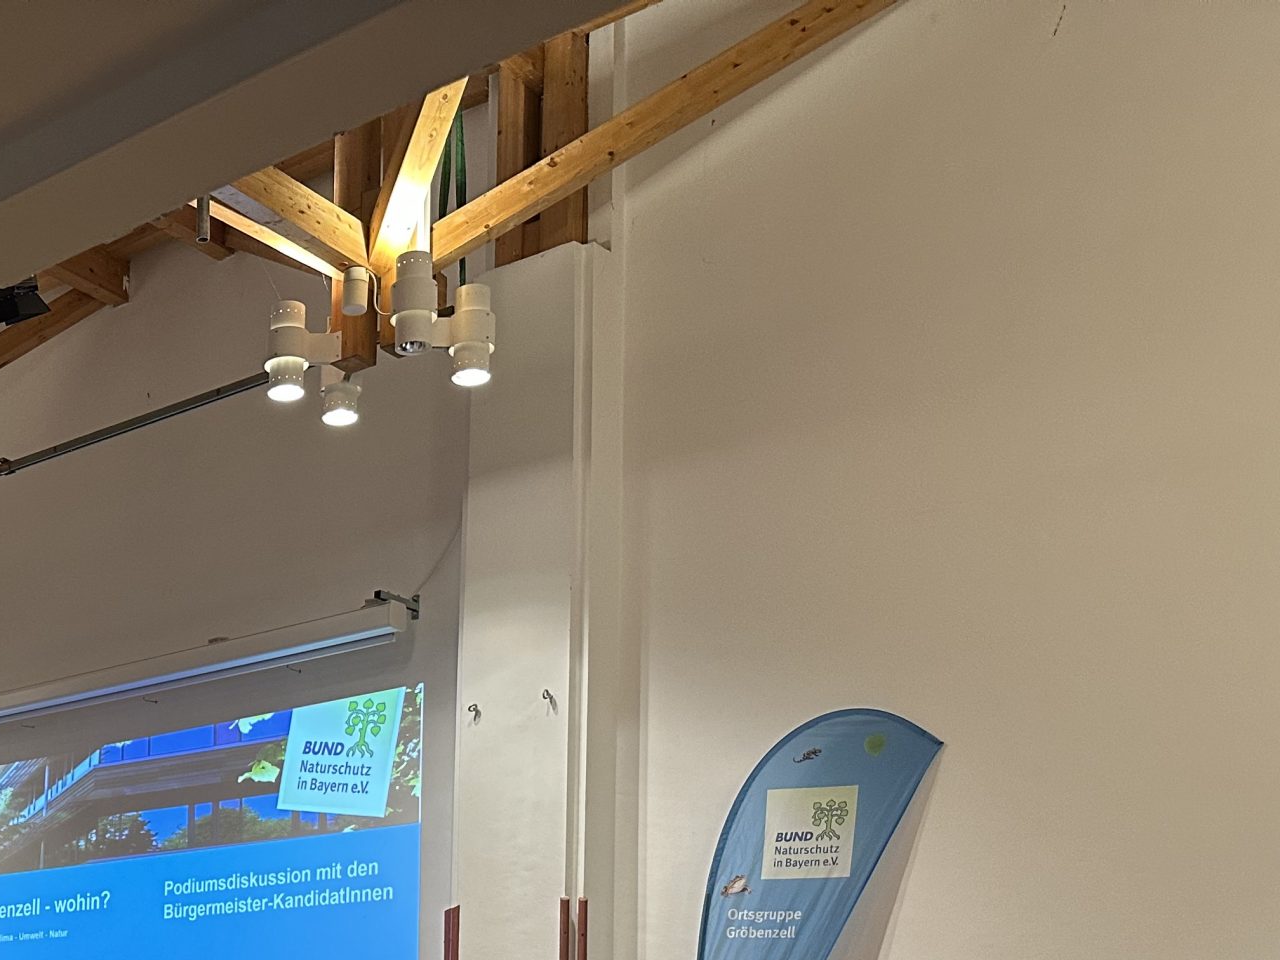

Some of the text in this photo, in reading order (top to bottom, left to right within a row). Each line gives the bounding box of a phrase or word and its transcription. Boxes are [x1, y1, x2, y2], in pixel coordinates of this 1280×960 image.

[302, 741, 345, 756] BUND
[299, 760, 372, 777] Naturschutz
[297, 776, 369, 795] in Bayern e.V.
[775, 831, 814, 843] BUND
[774, 844, 840, 856] Naturschutz
[773, 856, 839, 870] in Bayern e.V.
[164, 860, 379, 896] Podiumsdiskussion mit den
[54, 890, 111, 913] wohin?
[163, 886, 394, 921] Bürgermeister-KandidatInnen
[727, 908, 802, 923] Ortsgruppe
[49, 930, 68, 939] Natur
[726, 925, 796, 939] Gröbenzell
